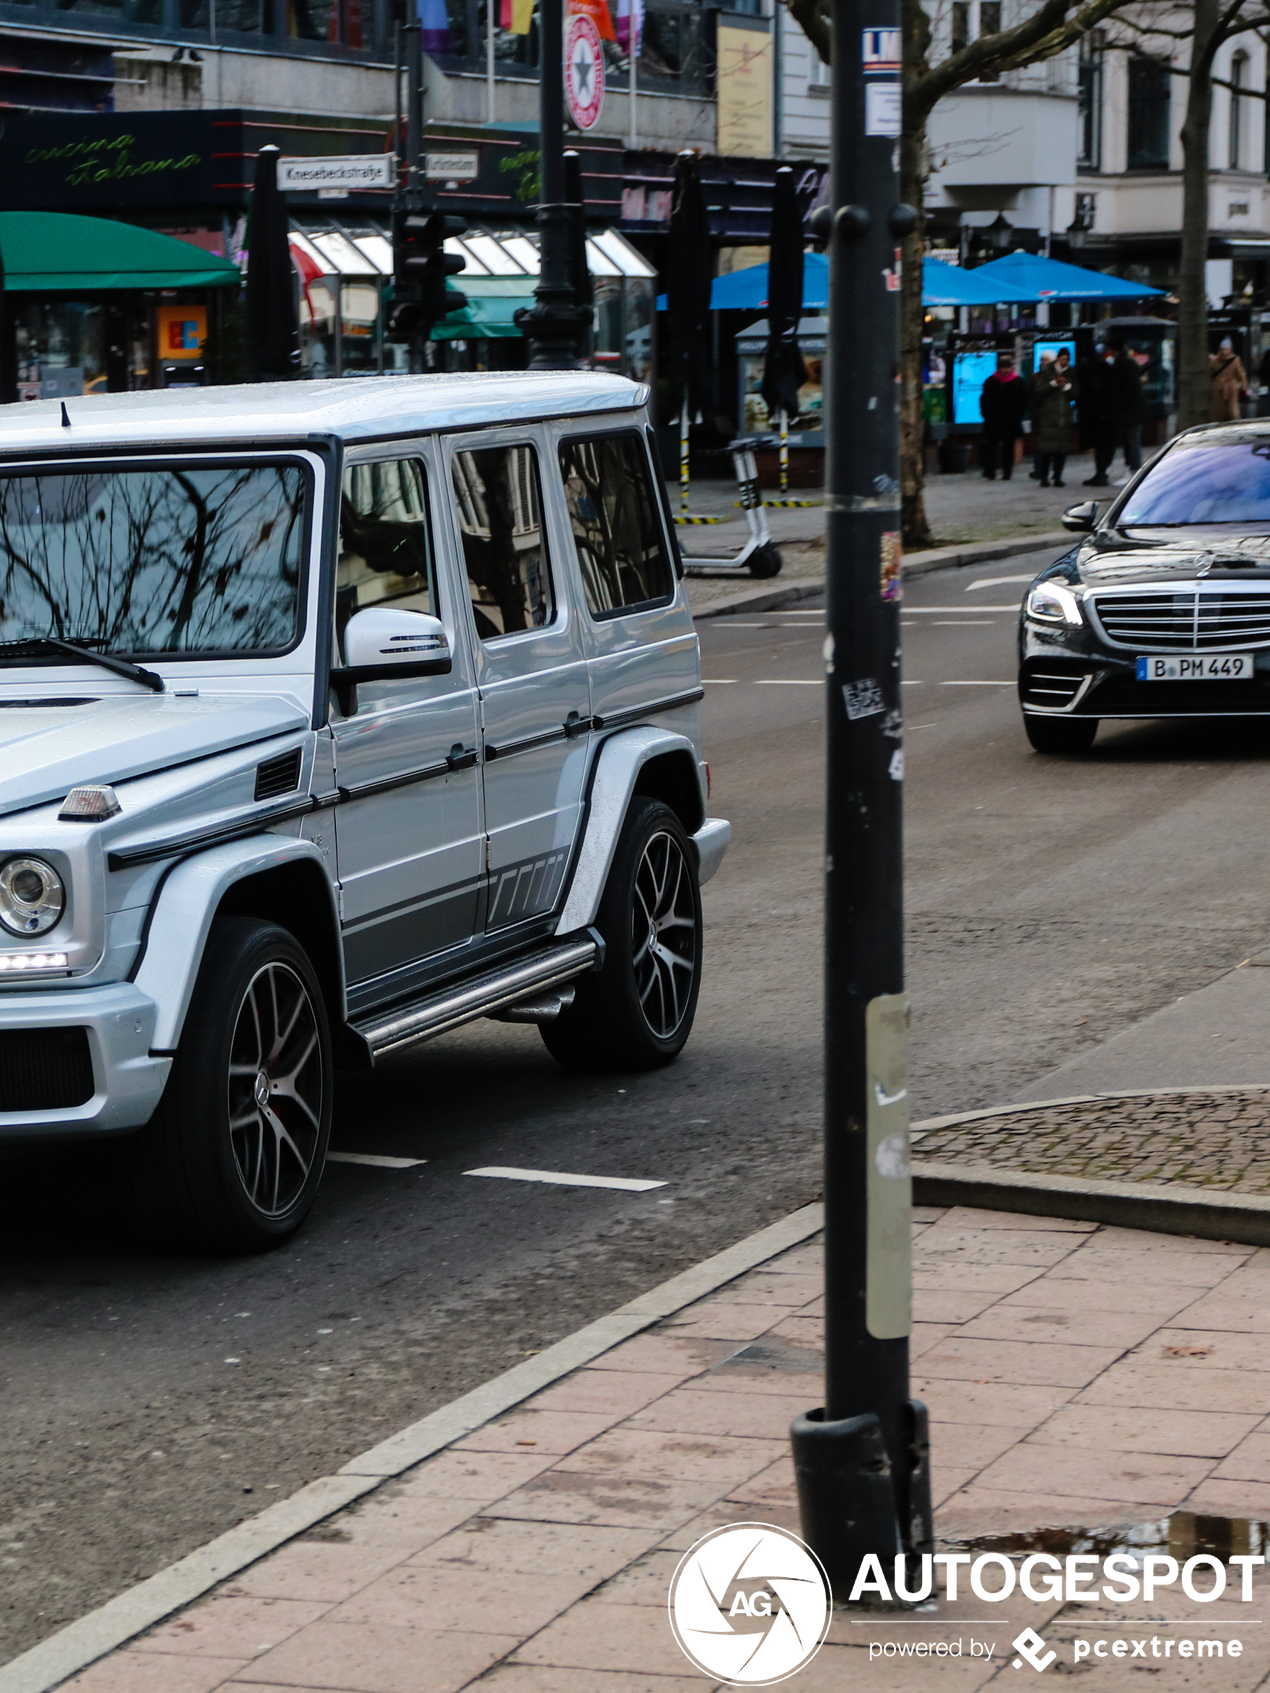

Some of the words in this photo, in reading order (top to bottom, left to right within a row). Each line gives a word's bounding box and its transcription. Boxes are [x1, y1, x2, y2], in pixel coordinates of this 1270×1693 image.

[27, 133, 136, 163] cucina
[285, 164, 384, 181] Knesebeckstraße
[1155, 660, 1166, 677] B
[1179, 660, 1203, 676] PM
[1209, 659, 1244, 676] 449
